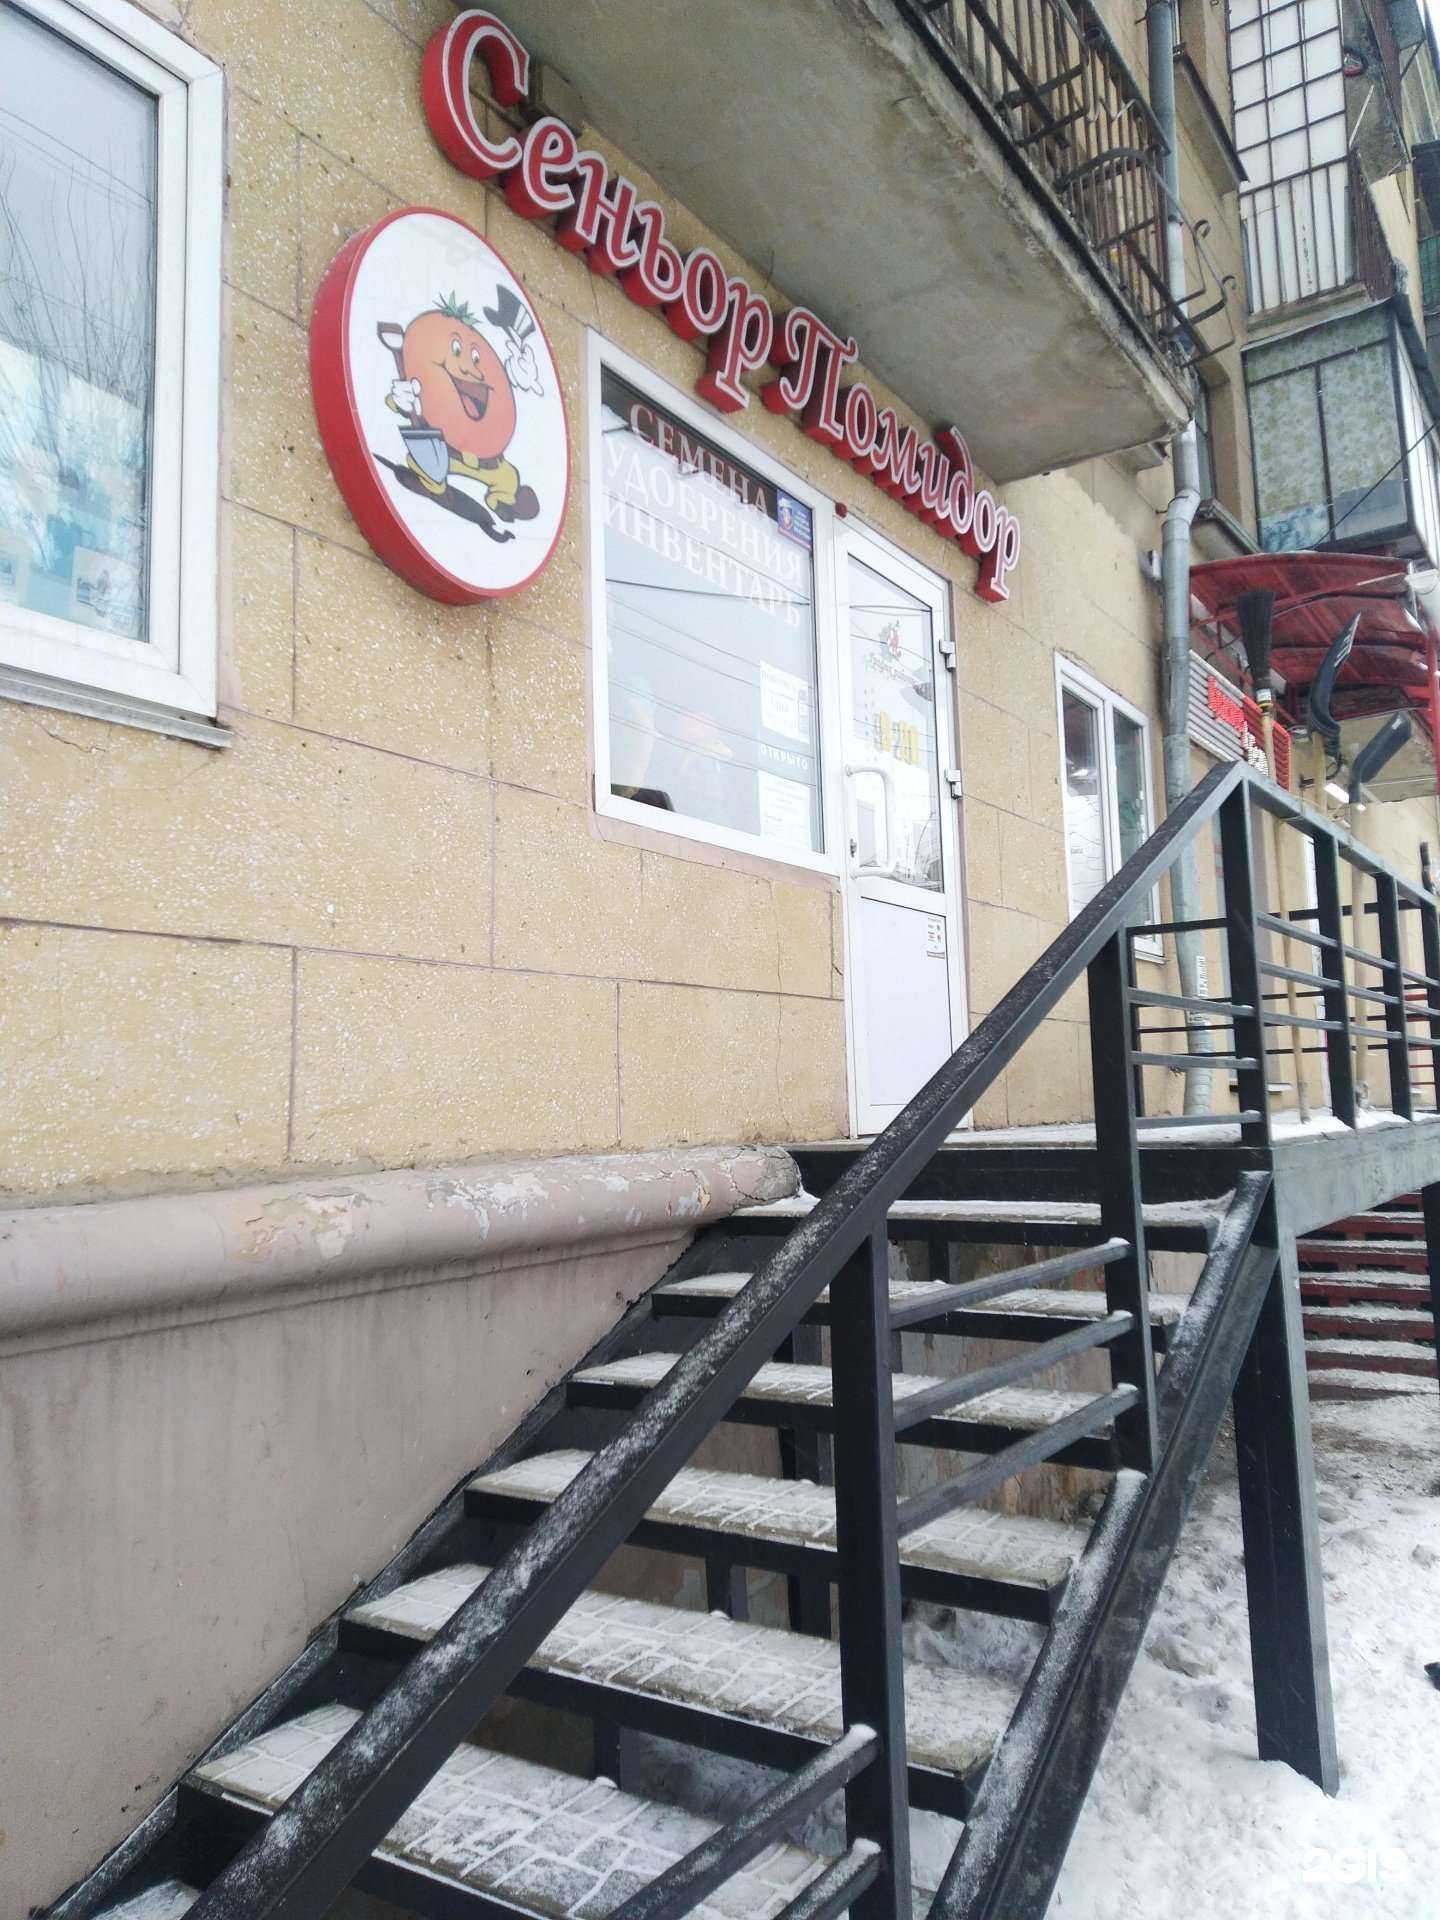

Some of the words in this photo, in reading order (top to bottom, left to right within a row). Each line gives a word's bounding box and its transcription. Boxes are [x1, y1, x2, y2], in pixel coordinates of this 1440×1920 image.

[434, 8, 774, 409] Сеньор
[778, 306, 1020, 600] Помидор
[606, 437, 804, 588] УДОБРЕНИЯ
[627, 402, 769, 516] СЕМЕНА
[604, 502, 801, 627] ИНВЕНТАРЬ
[760, 742, 808, 771] ОТКРЫТО
